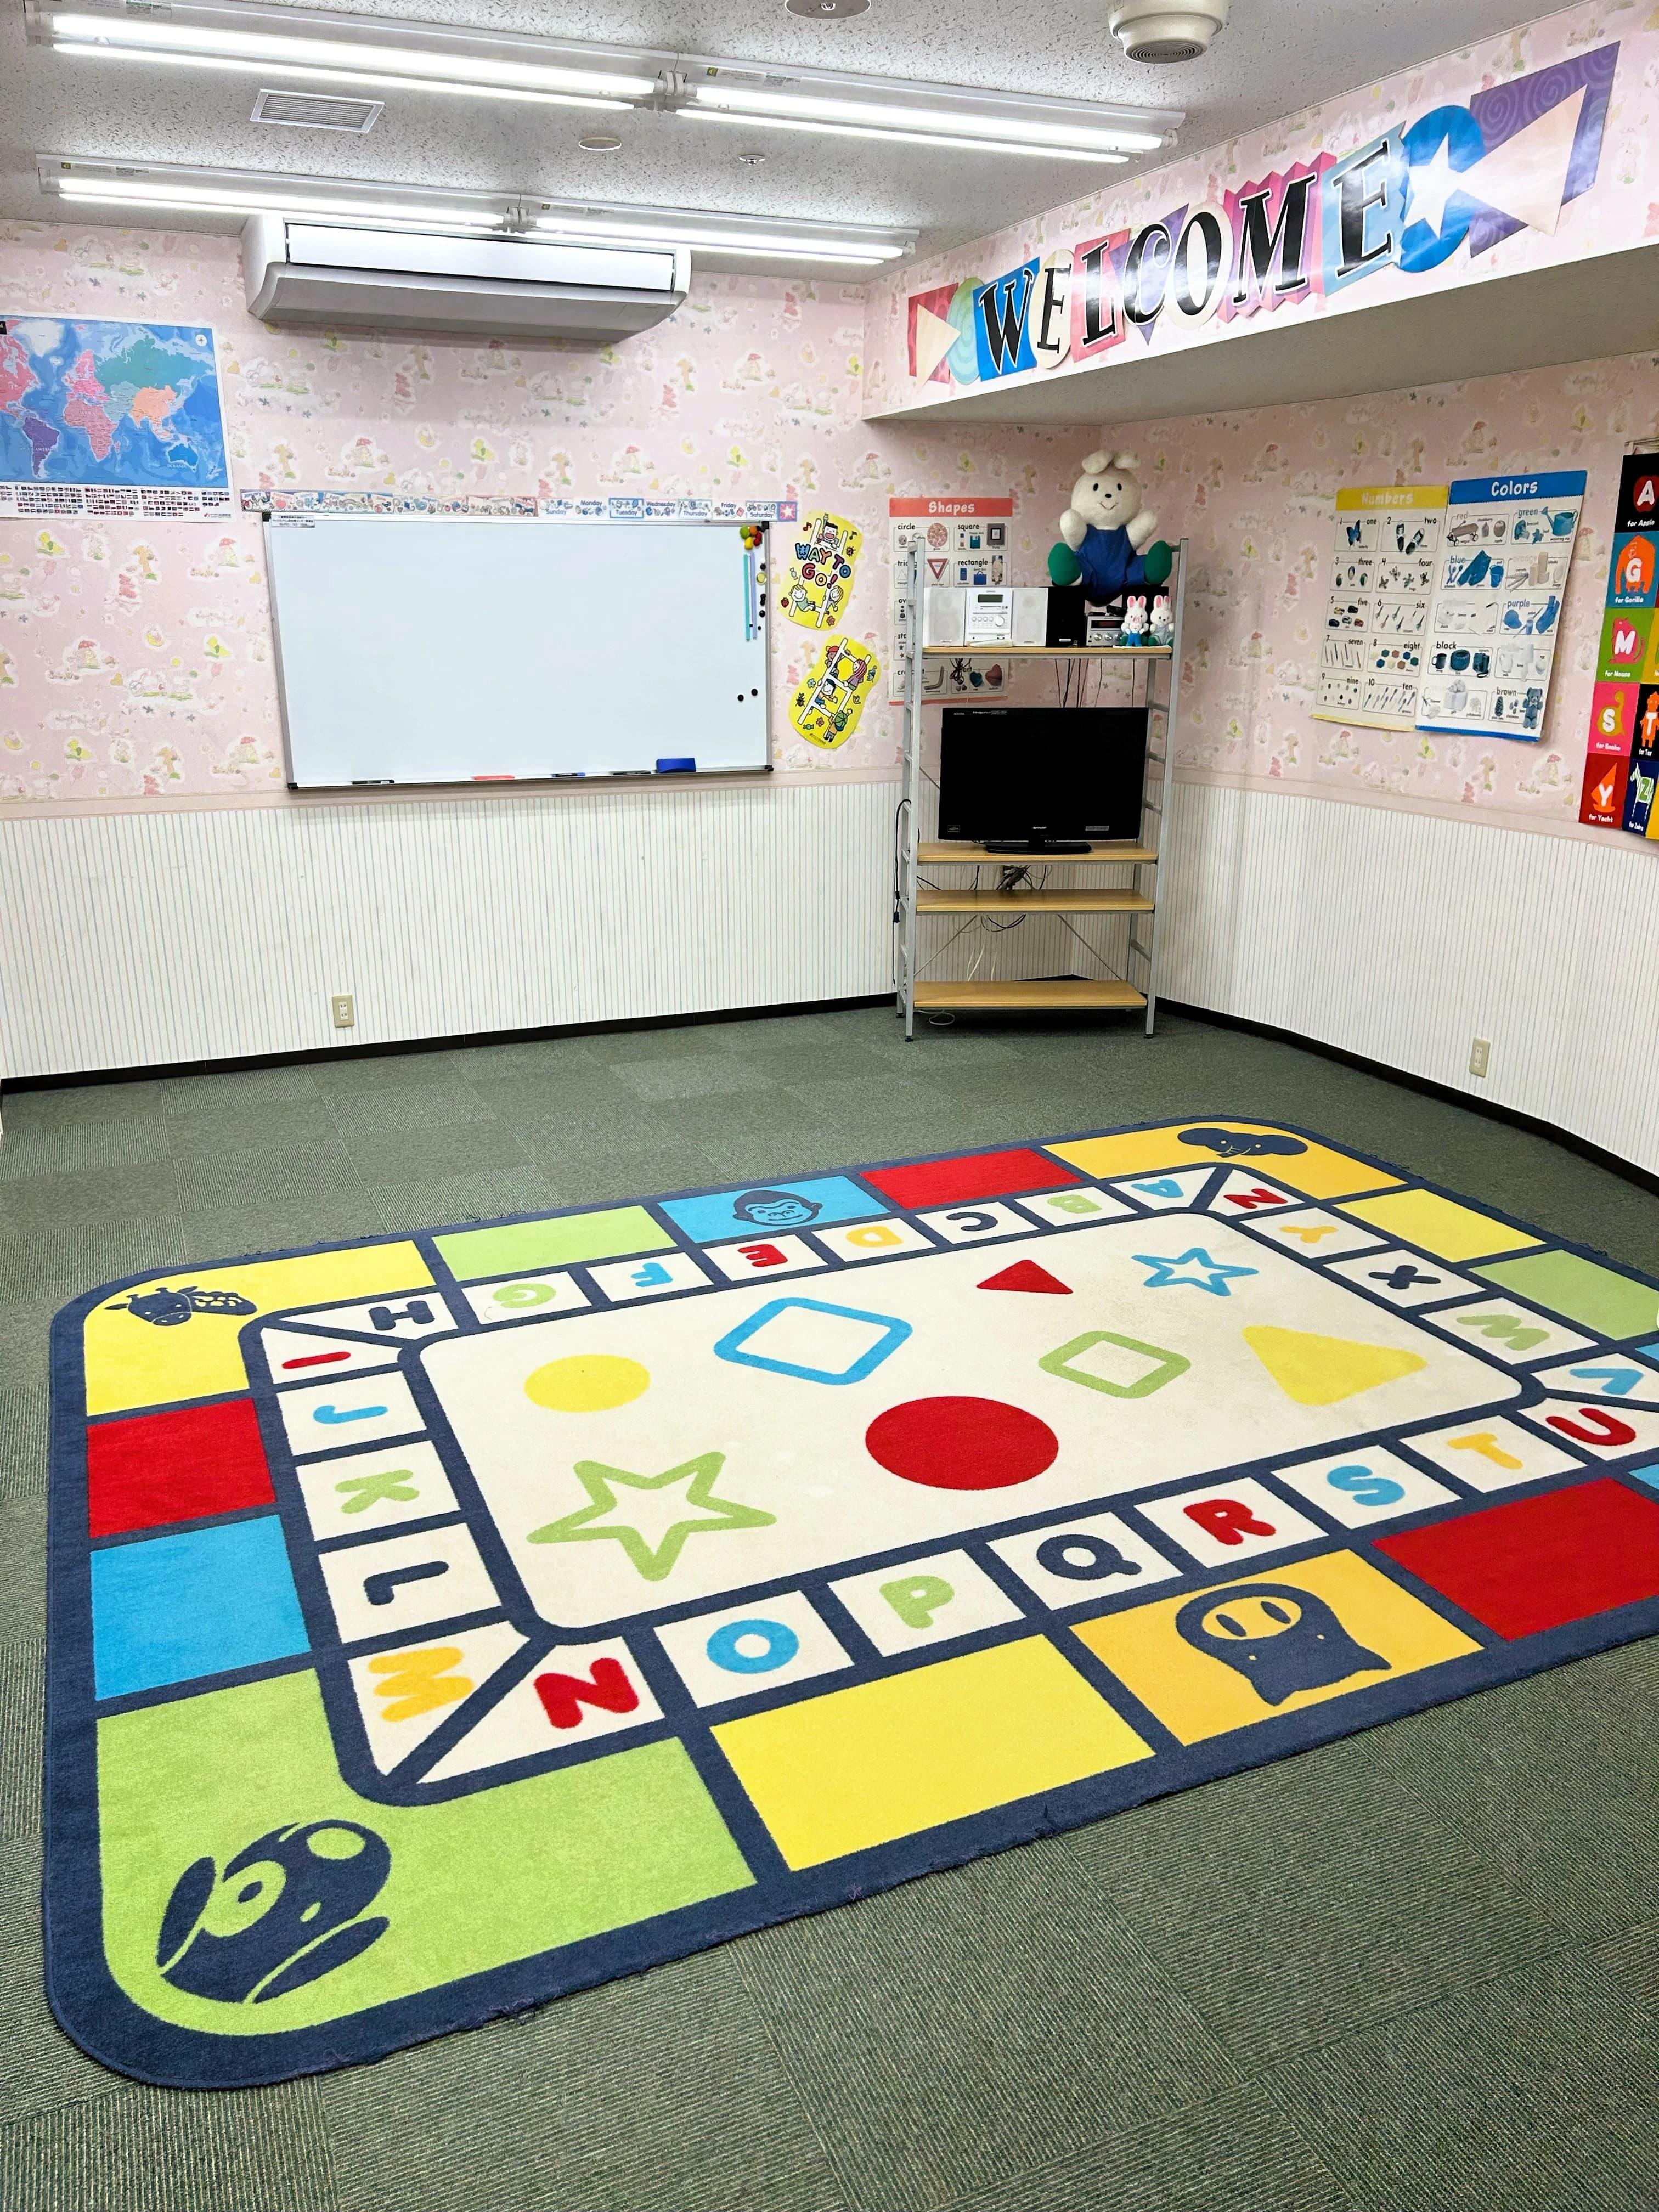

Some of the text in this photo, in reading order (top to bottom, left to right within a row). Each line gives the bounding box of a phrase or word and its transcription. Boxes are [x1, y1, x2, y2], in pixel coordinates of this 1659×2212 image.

[978, 139, 1392, 374] WELCOME
[1361, 491, 1414, 505] Numbers
[1491, 480, 1538, 497] Colors
[1637, 479, 1655, 506] A
[928, 501, 975, 516] Shapes
[1455, 511, 1469, 520] red
[1517, 508, 1538, 518] green
[897, 522, 916, 531] circle
[957, 523, 980, 532] square
[1386, 517, 1392, 525] 2
[794, 542, 852, 579] WAY TO
[957, 557, 989, 568] rectangle
[1334, 557, 1373, 566] 3 three
[1381, 557, 1433, 567] 4 four
[1449, 555, 1466, 564] blue
[801, 562, 838, 589] GO!
[1626, 557, 1643, 584] G
[1330, 596, 1368, 606] 5 five
[1378, 599, 1426, 609] 6 six
[1507, 598, 1531, 609] purple
[1348, 637, 1364, 646] seven
[1373, 638, 1420, 652] 8 eight
[1436, 640, 1457, 650] black
[1614, 630, 1637, 656] M
[1321, 672, 1359, 685] 9 nine
[1368, 678, 1413, 690] 10 ten
[1496, 686, 1517, 696] brown
[1602, 708, 1616, 733] S
[1645, 712, 1657, 736] T
[1598, 782, 1614, 808] Y
[1640, 778, 1651, 802] Z
[1131, 1178, 1184, 1199] A
[1047, 1194, 1103, 1214] B
[946, 1211, 998, 1232] C
[845, 1225, 905, 1248] D
[1279, 1225, 1338, 1244] Y
[737, 1243, 789, 1268] E
[630, 1262, 673, 1288] F
[1367, 1264, 1442, 1290] X
[368, 1300, 435, 1331] H
[313, 1404, 389, 1425] J
[334, 1469, 421, 1515] K
[533, 1407, 1637, 1730] N O P Q R S T U
[363, 1560, 449, 1606] L
[367, 1646, 475, 1723] M
